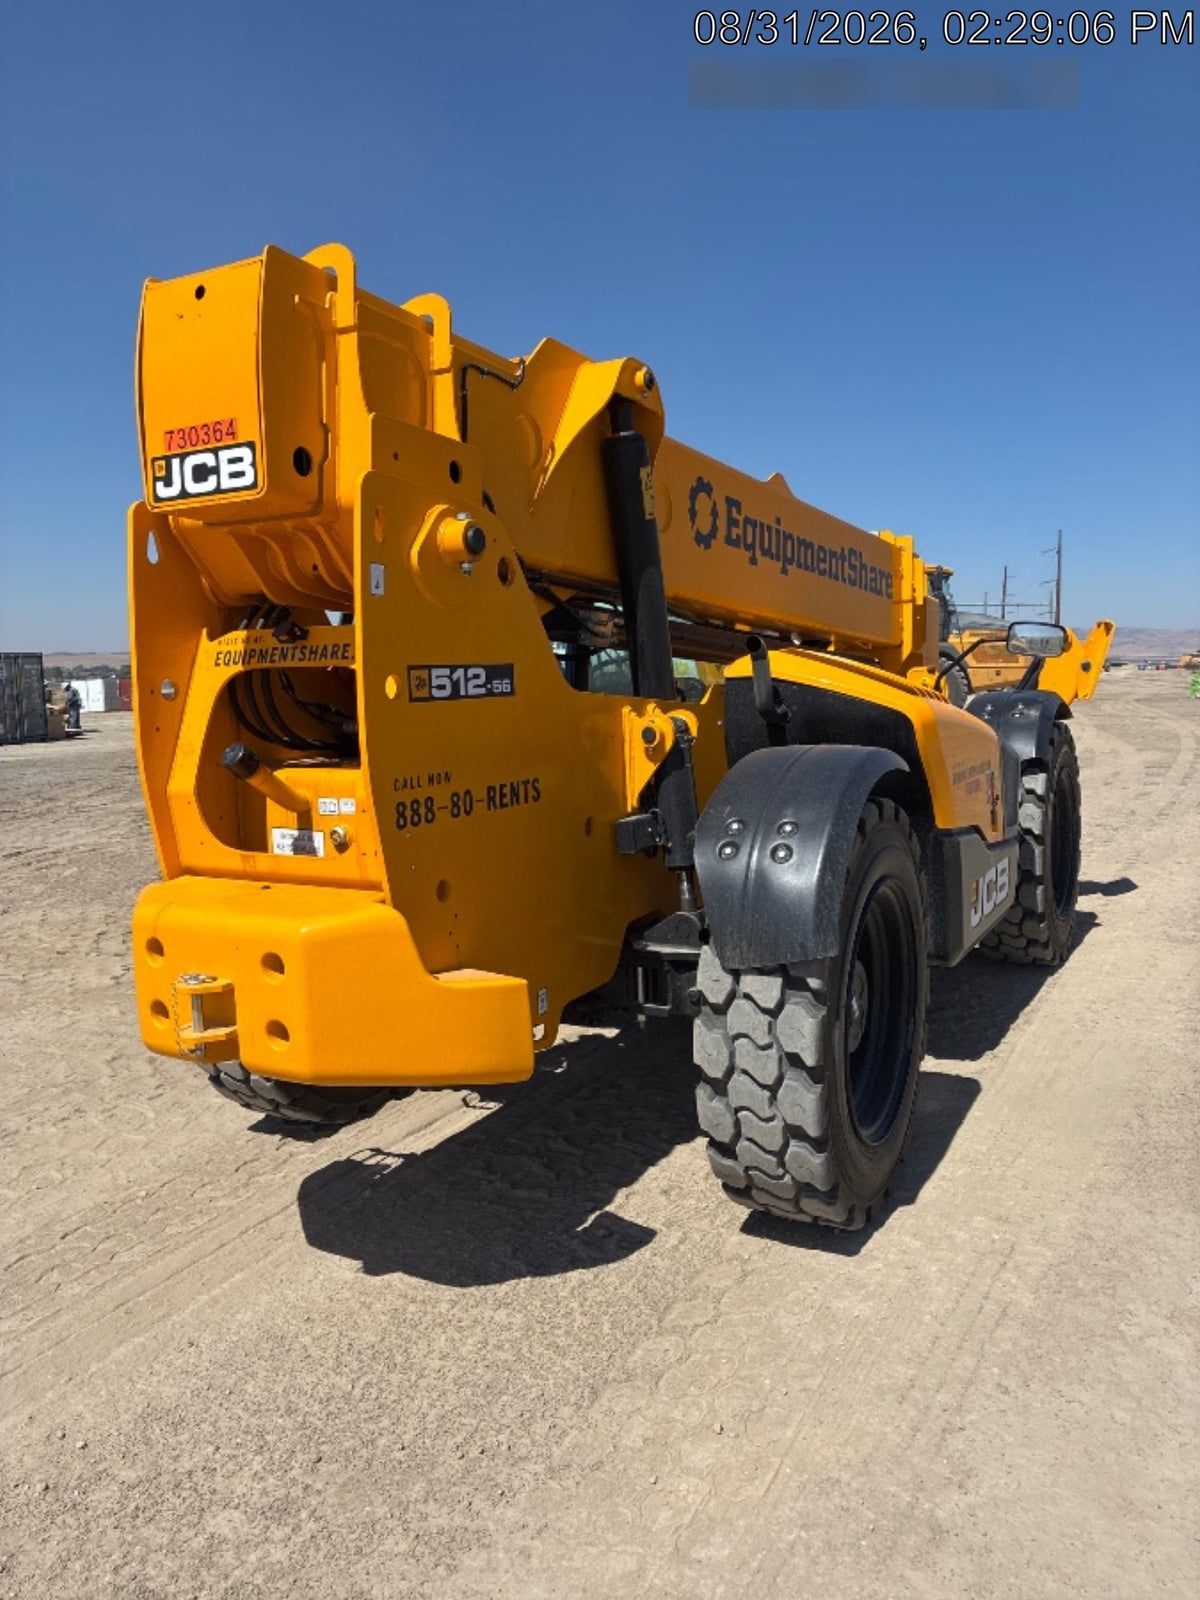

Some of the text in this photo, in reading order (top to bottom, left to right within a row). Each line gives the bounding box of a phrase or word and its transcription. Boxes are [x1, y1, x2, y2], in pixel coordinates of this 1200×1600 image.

[164, 419, 237, 452] 730364
[154, 446, 256, 498] JCB
[724, 495, 894, 600] EquipmentShare
[393, 776, 423, 792] CALL
[395, 777, 542, 831] 888-80-RENTS
[970, 856, 1009, 928] JCB
